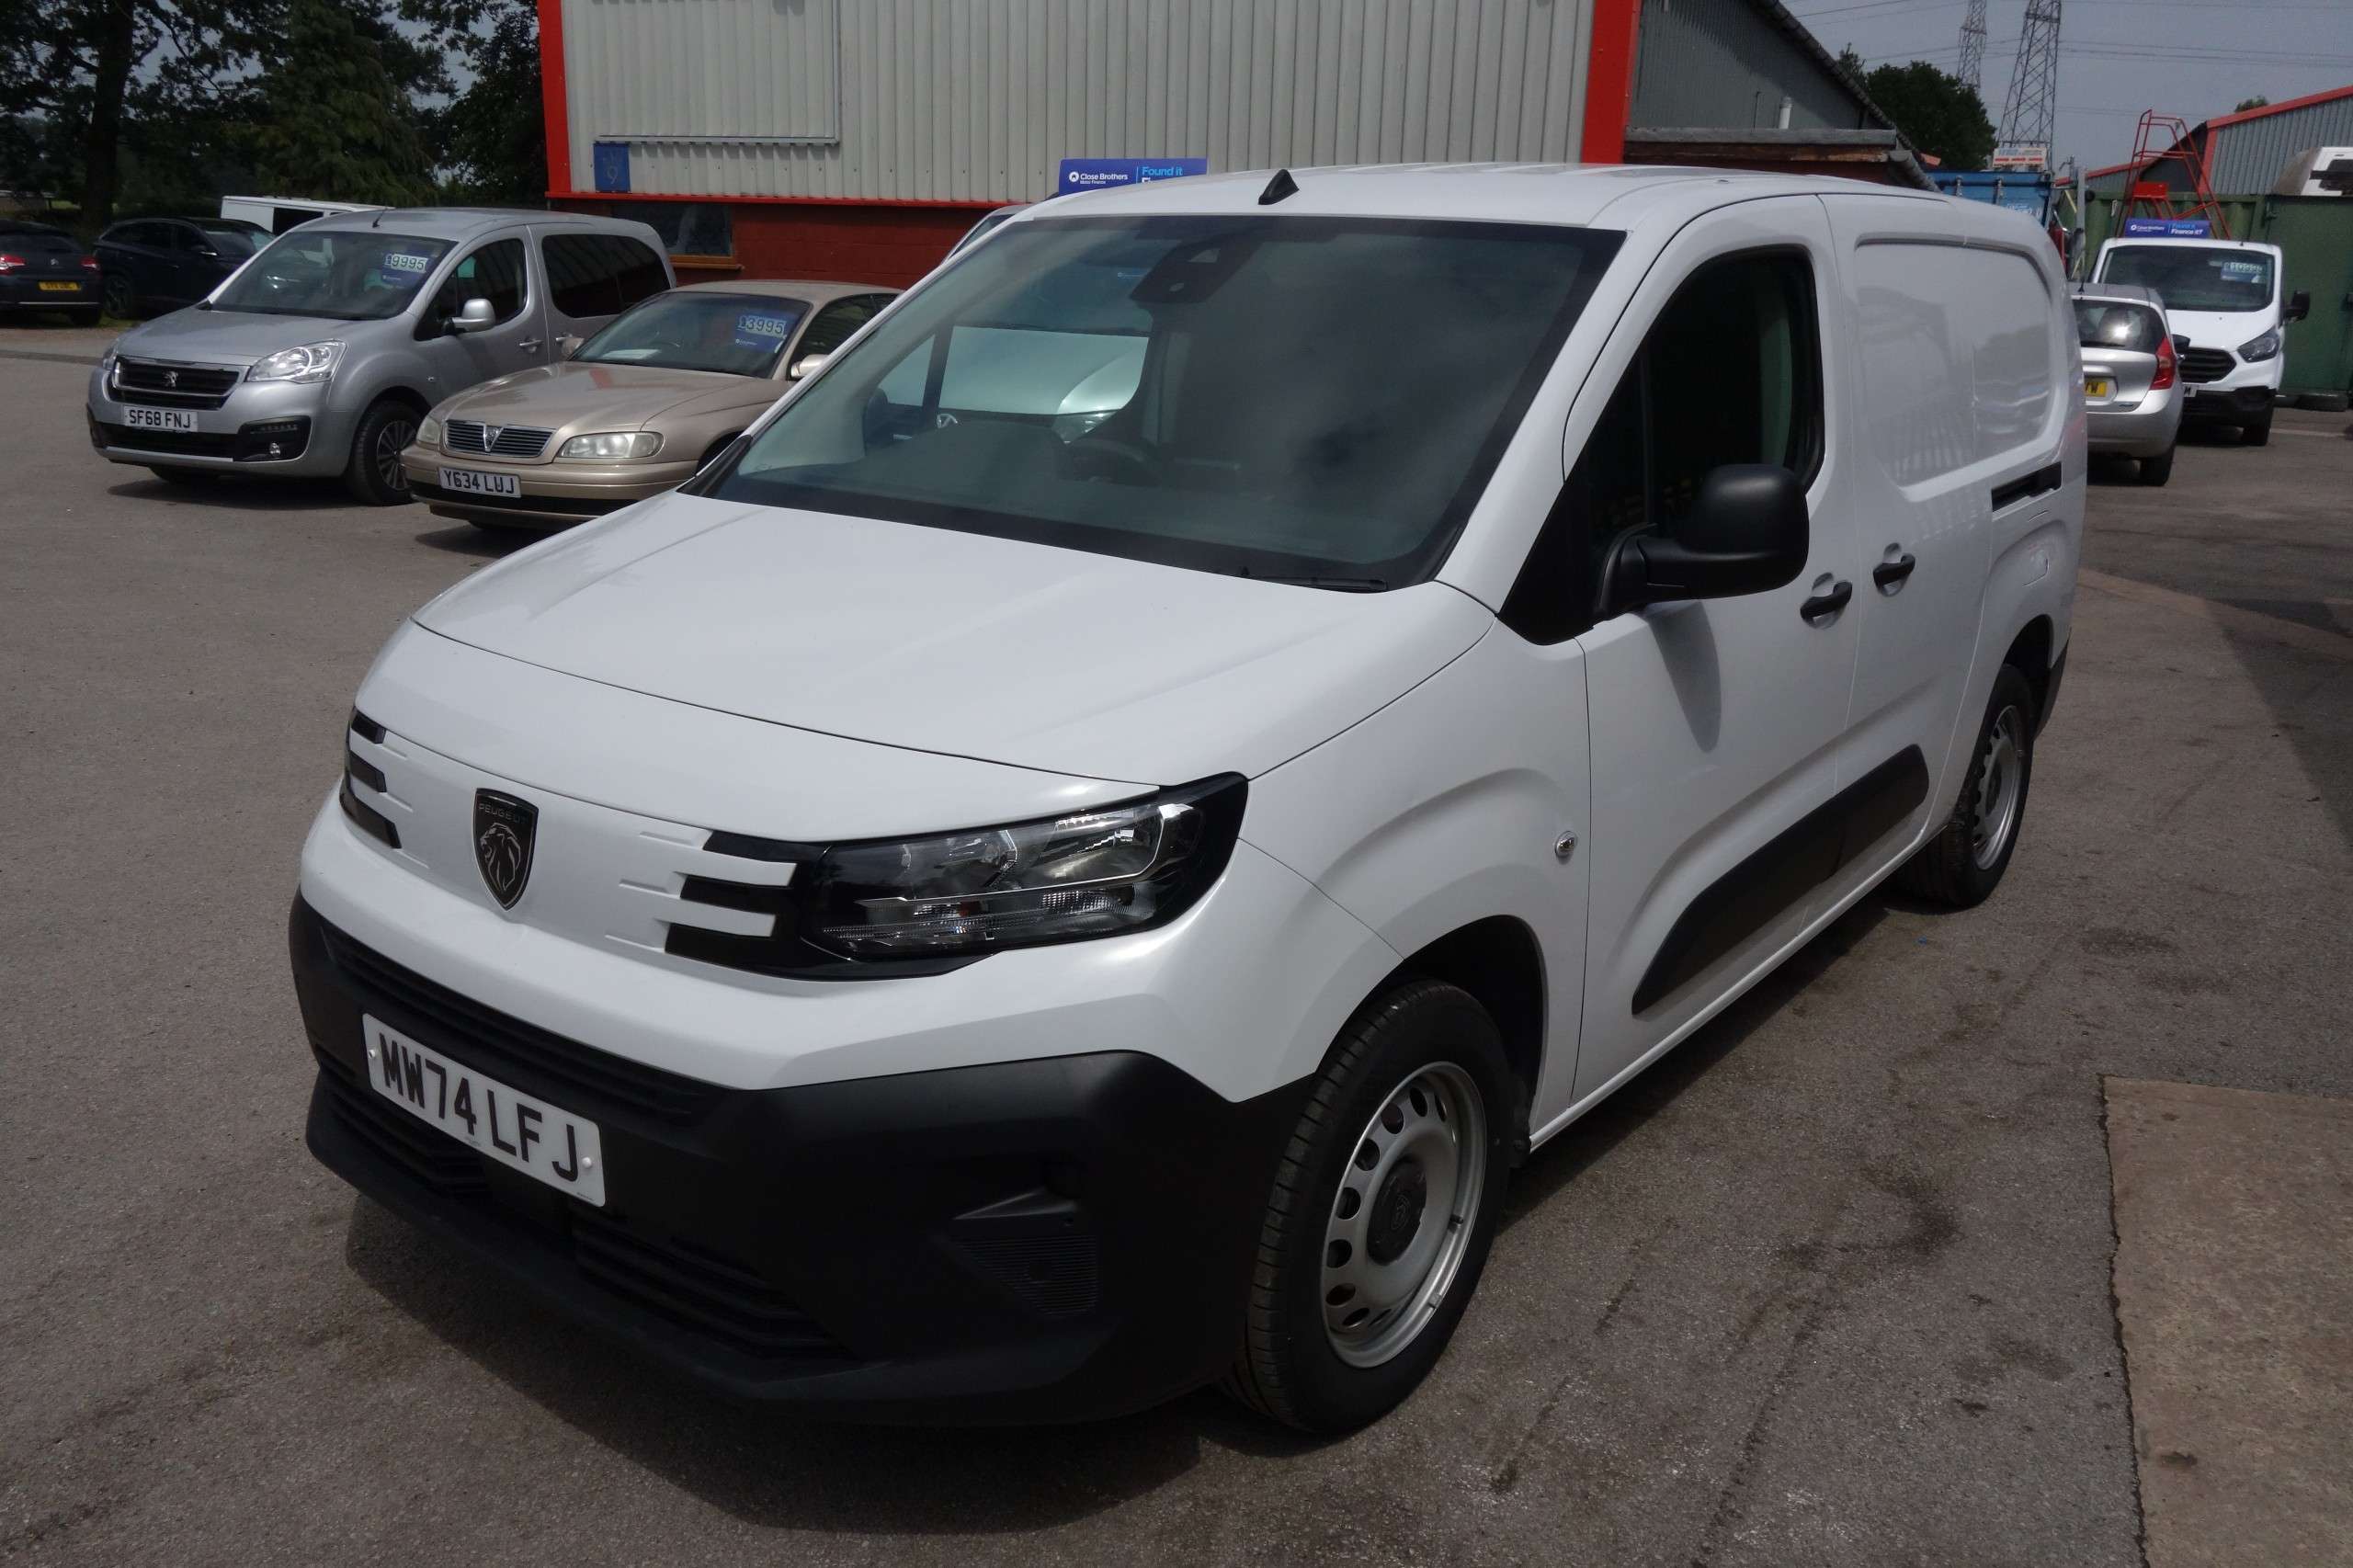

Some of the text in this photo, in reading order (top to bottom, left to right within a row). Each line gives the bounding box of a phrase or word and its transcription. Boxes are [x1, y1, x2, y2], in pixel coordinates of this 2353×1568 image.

[1099, 173, 1129, 181] Brothers
[1142, 166, 1184, 176] Found it
[736, 315, 783, 334] £3995
[130, 409, 191, 428] SF68 FNJ
[444, 470, 515, 494] Y634 LUJ
[478, 802, 529, 825] PEUGEOT
[379, 1031, 579, 1183] MW74 LFJ
